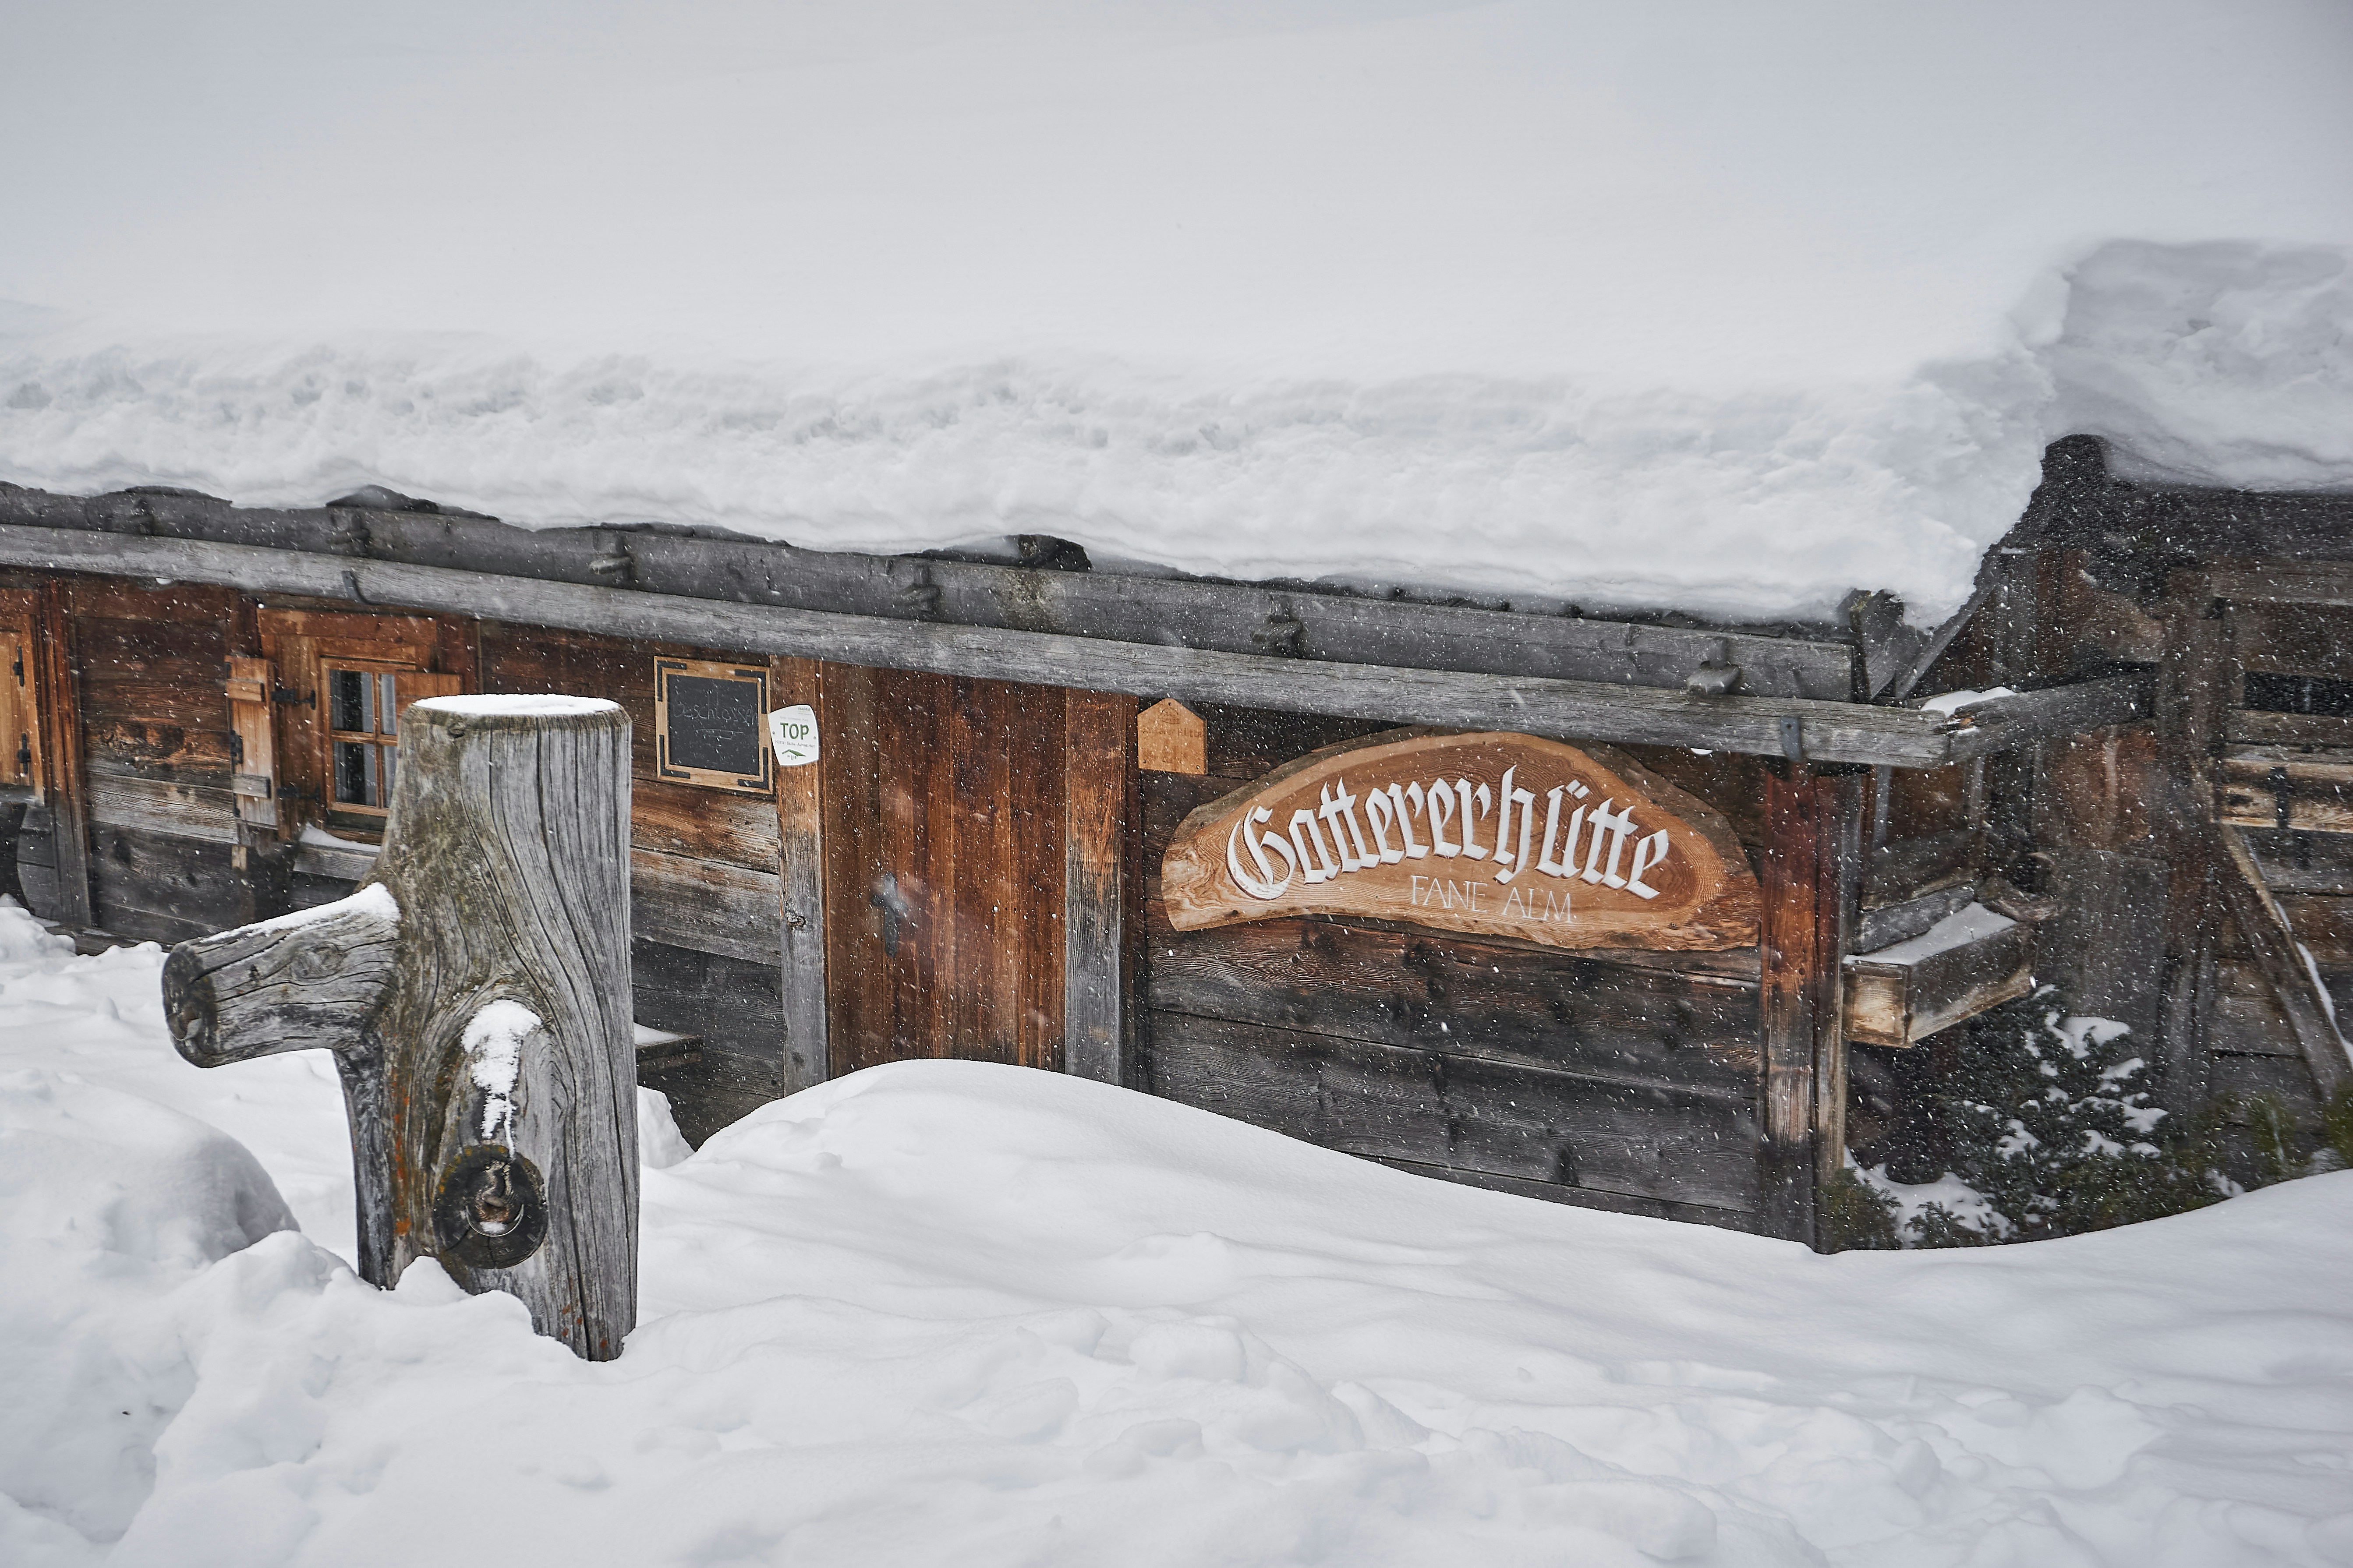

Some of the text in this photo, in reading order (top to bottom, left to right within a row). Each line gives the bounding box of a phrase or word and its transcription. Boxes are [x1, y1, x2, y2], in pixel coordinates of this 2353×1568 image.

[780, 722, 809, 739] TOP
[1227, 764, 1669, 900] Gattererhütte
[1410, 875, 1572, 922] FANE ALM
